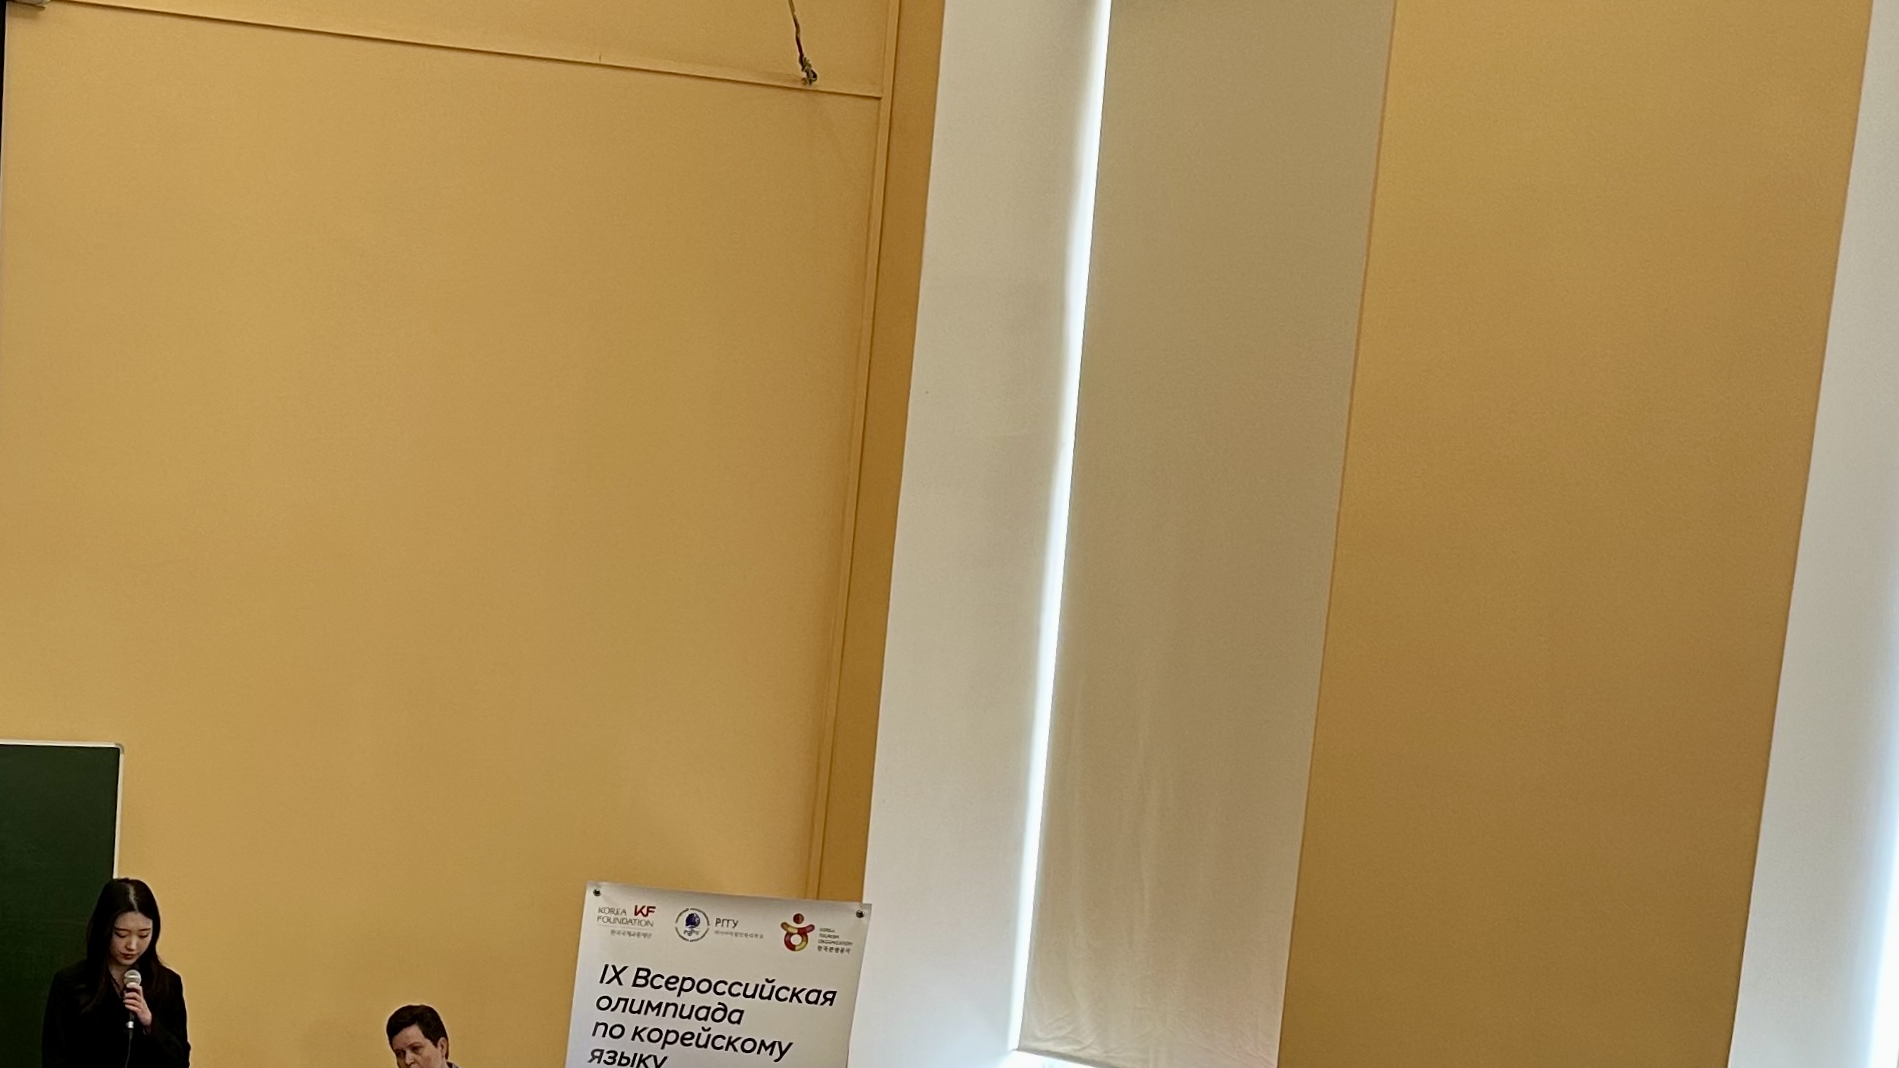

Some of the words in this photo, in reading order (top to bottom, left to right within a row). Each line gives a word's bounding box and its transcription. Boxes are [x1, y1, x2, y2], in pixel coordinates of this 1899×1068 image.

[598, 907, 627, 916] KOREA
[634, 904, 656, 917] KF
[597, 916, 654, 927] FOUNDATION
[715, 917, 739, 929] РГГУ
[599, 964, 629, 986] IX
[631, 967, 837, 1006] Всероссийская
[595, 995, 745, 1025] олимпиада
[592, 1021, 625, 1039] по
[631, 1026, 793, 1063] корейскому
